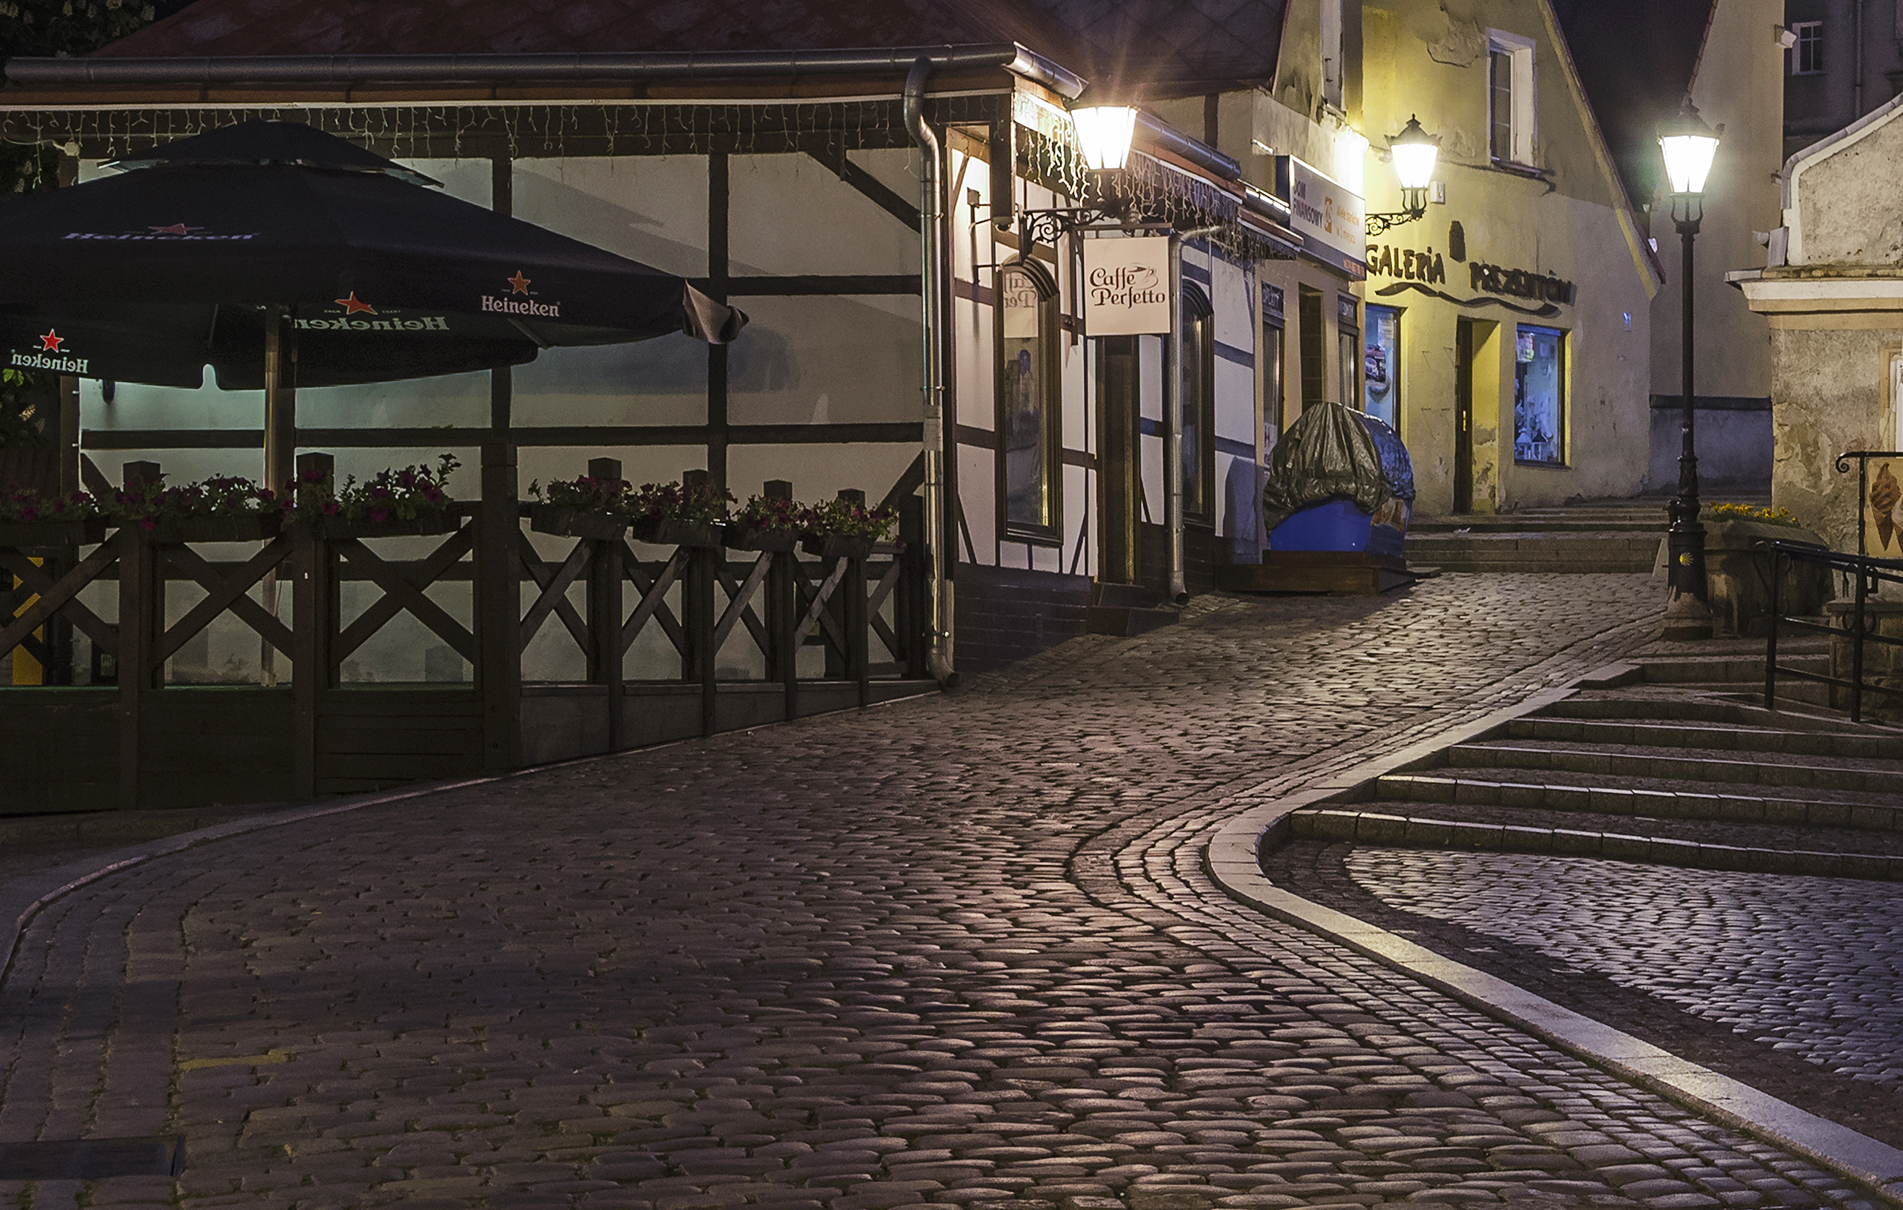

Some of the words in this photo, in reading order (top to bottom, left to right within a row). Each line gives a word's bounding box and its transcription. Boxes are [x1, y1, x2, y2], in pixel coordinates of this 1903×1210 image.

[1090, 267, 1136, 290] Caffe
[481, 294, 560, 318] Heineken
[1091, 287, 1165, 309] Perfetto
